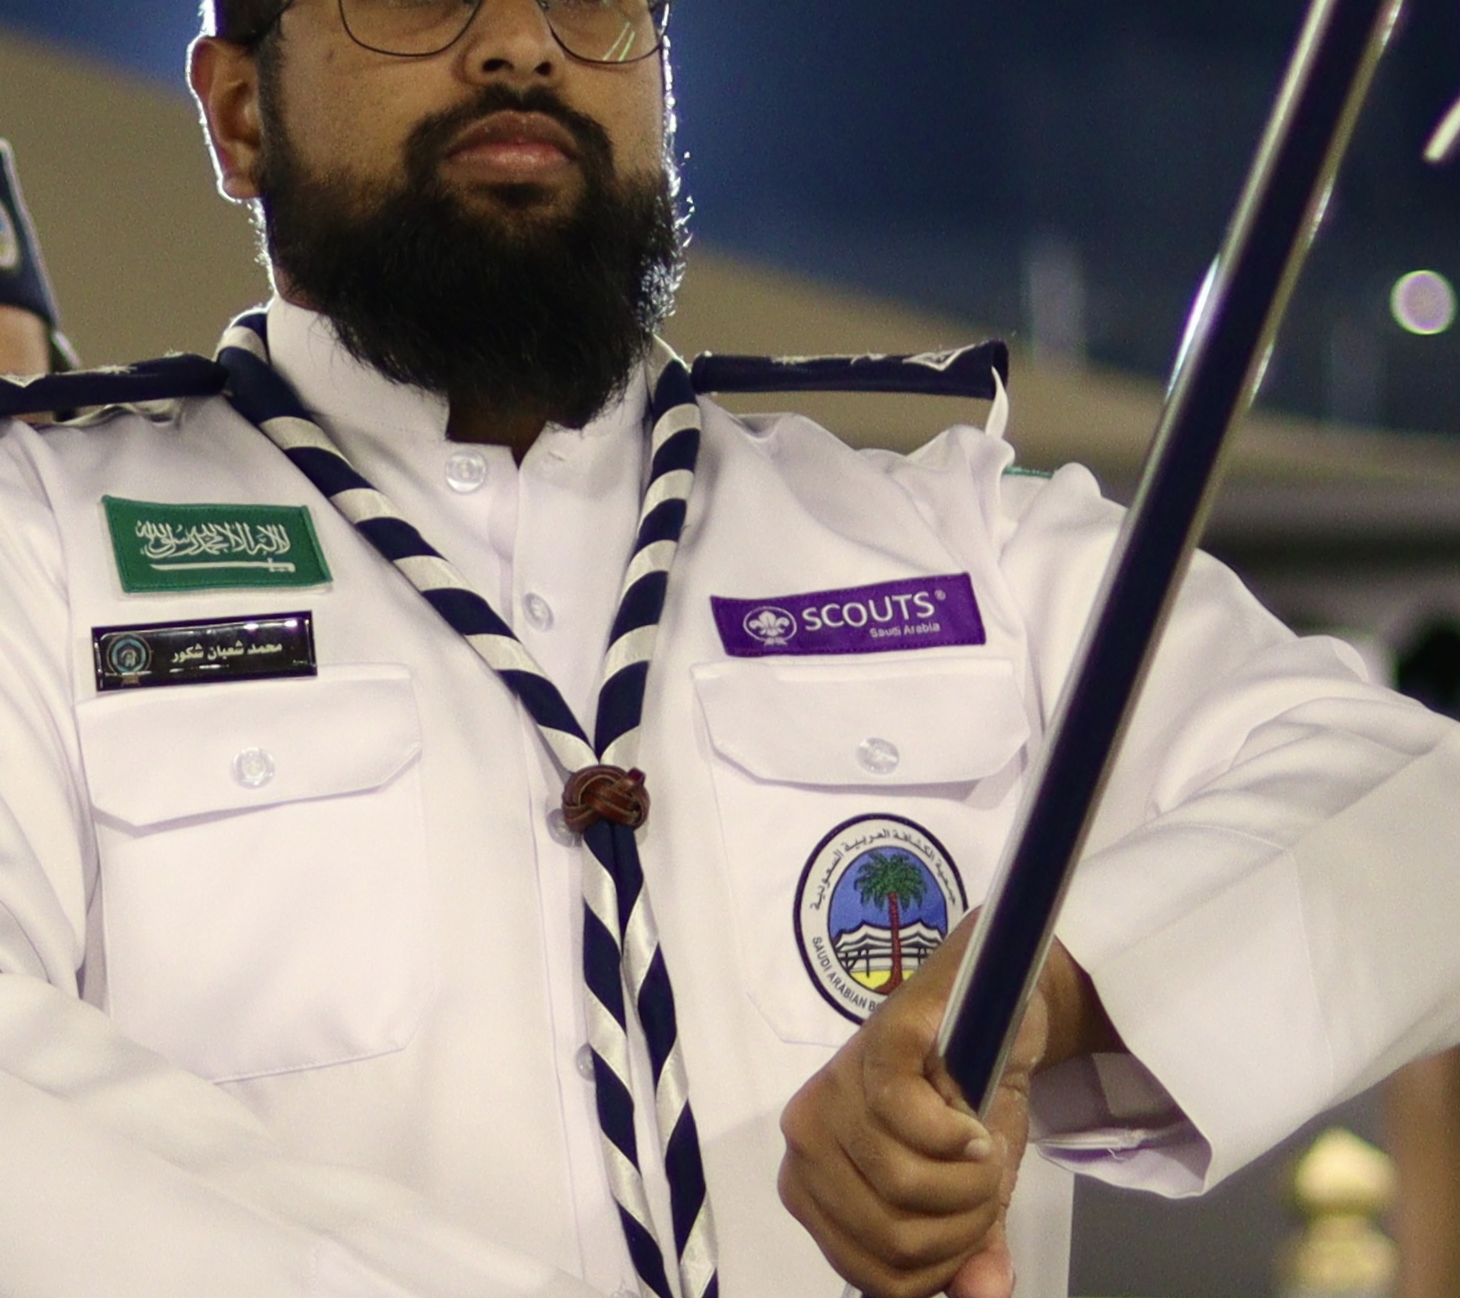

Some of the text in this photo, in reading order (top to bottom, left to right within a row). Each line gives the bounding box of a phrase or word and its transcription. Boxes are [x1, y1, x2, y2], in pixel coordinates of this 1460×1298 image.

[869, 621, 940, 638] Saudi Arabia
[171, 640, 283, 663] محمد شعبان شكور
[812, 936, 833, 973] SAUDI
[827, 972, 868, 1008] ARABIAN
